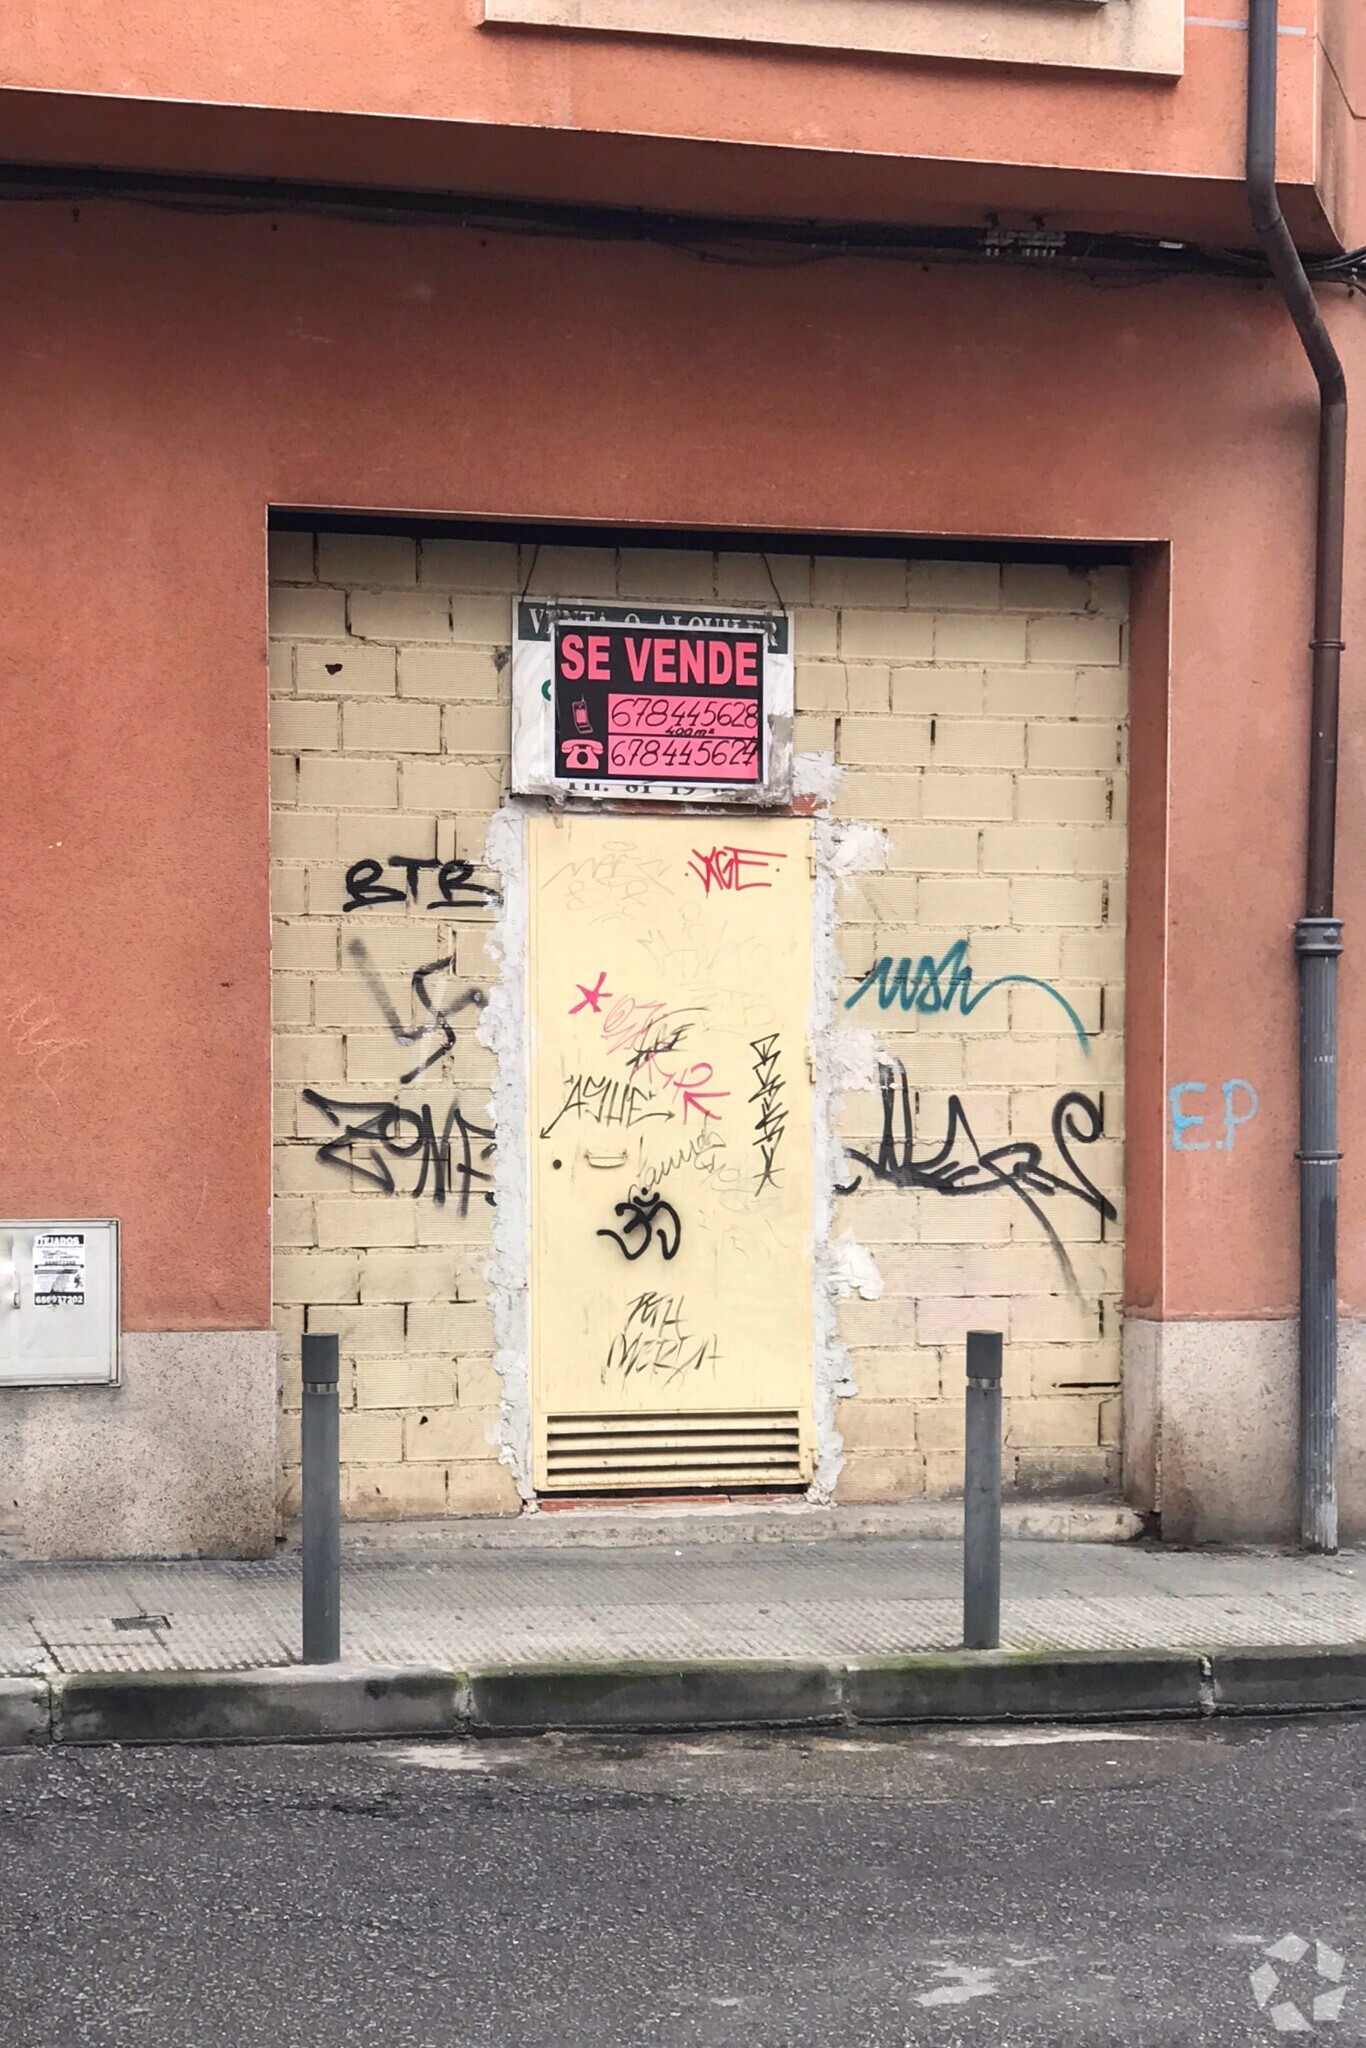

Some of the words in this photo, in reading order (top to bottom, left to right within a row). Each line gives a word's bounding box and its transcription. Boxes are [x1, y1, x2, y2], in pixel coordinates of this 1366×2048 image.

[560, 634, 611, 681] SE
[624, 637, 758, 686] VENDE
[611, 697, 759, 729] 678445628
